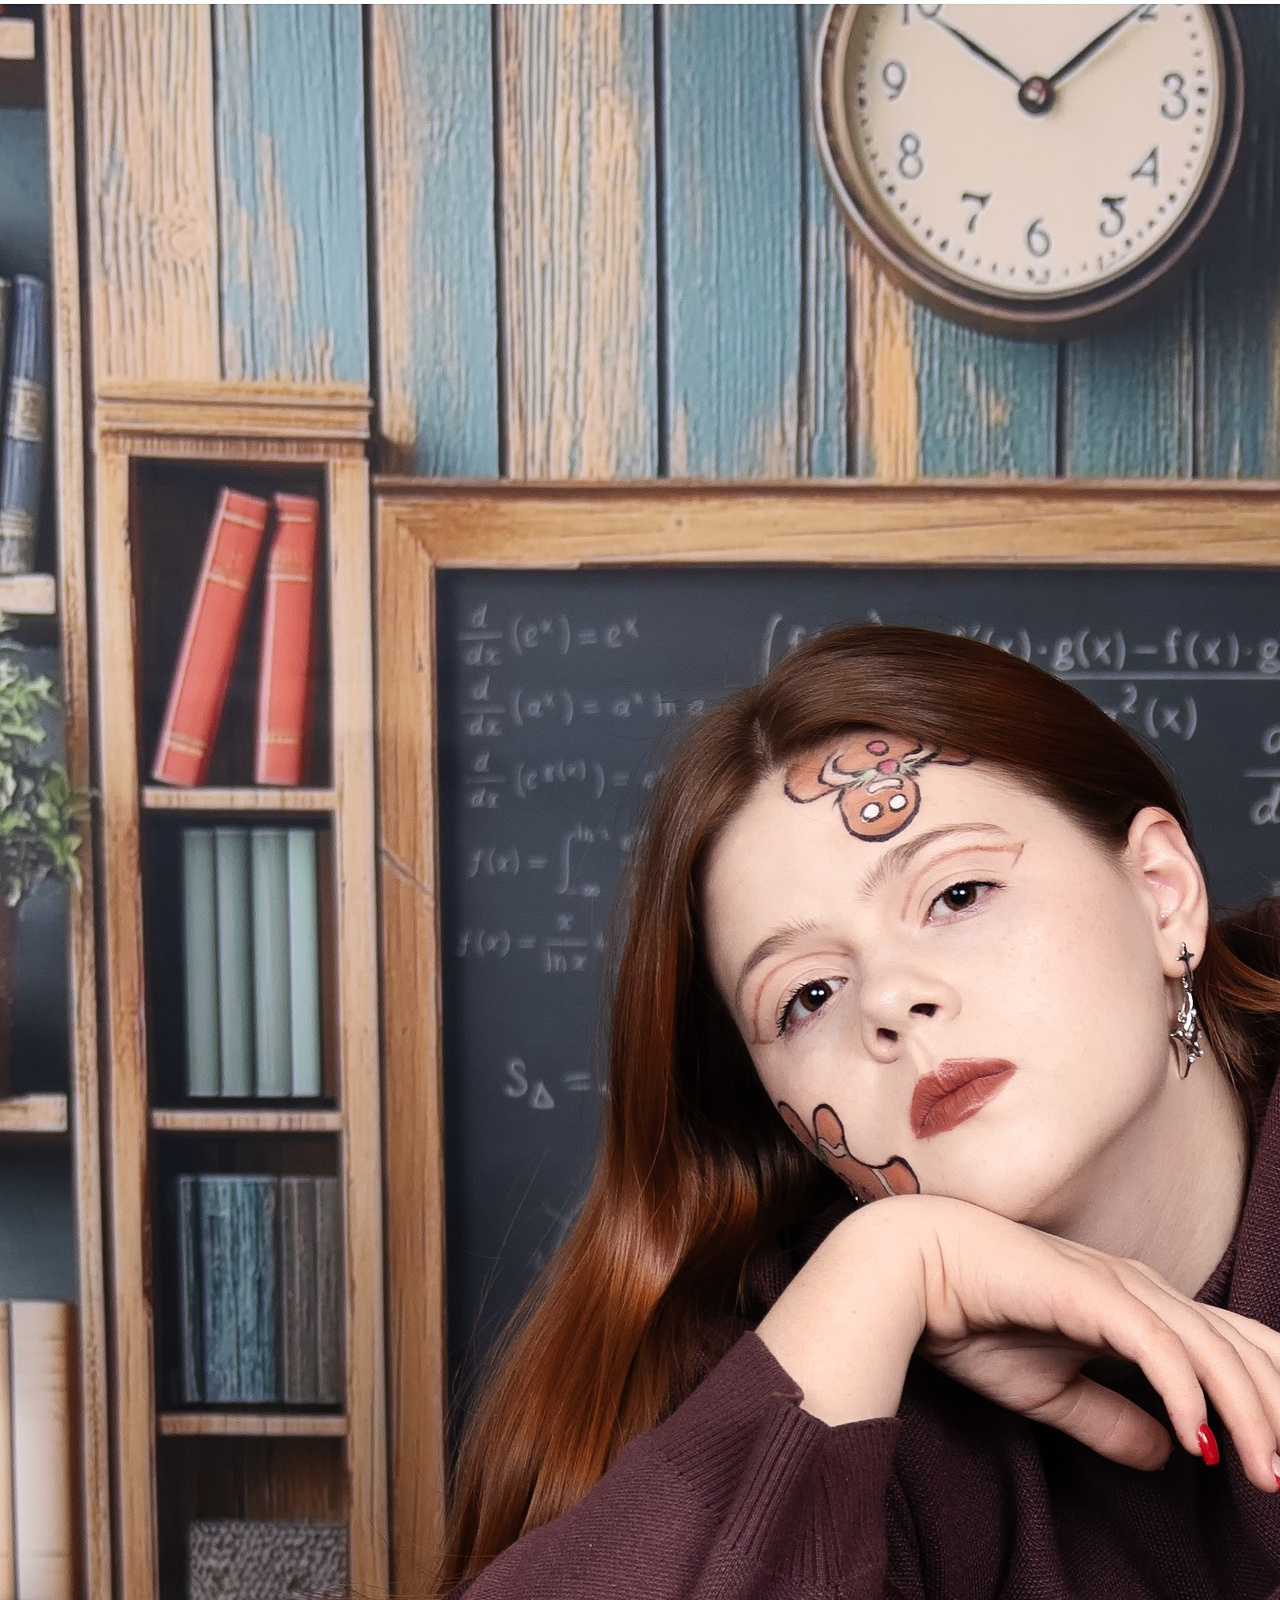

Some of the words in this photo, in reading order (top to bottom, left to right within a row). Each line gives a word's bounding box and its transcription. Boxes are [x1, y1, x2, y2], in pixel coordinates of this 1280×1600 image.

[883, 61, 906, 99] 9
[1161, 73, 1188, 119] 3
[900, 134, 923, 179] 8
[962, 193, 992, 233] 7
[1027, 218, 1050, 257] 6
